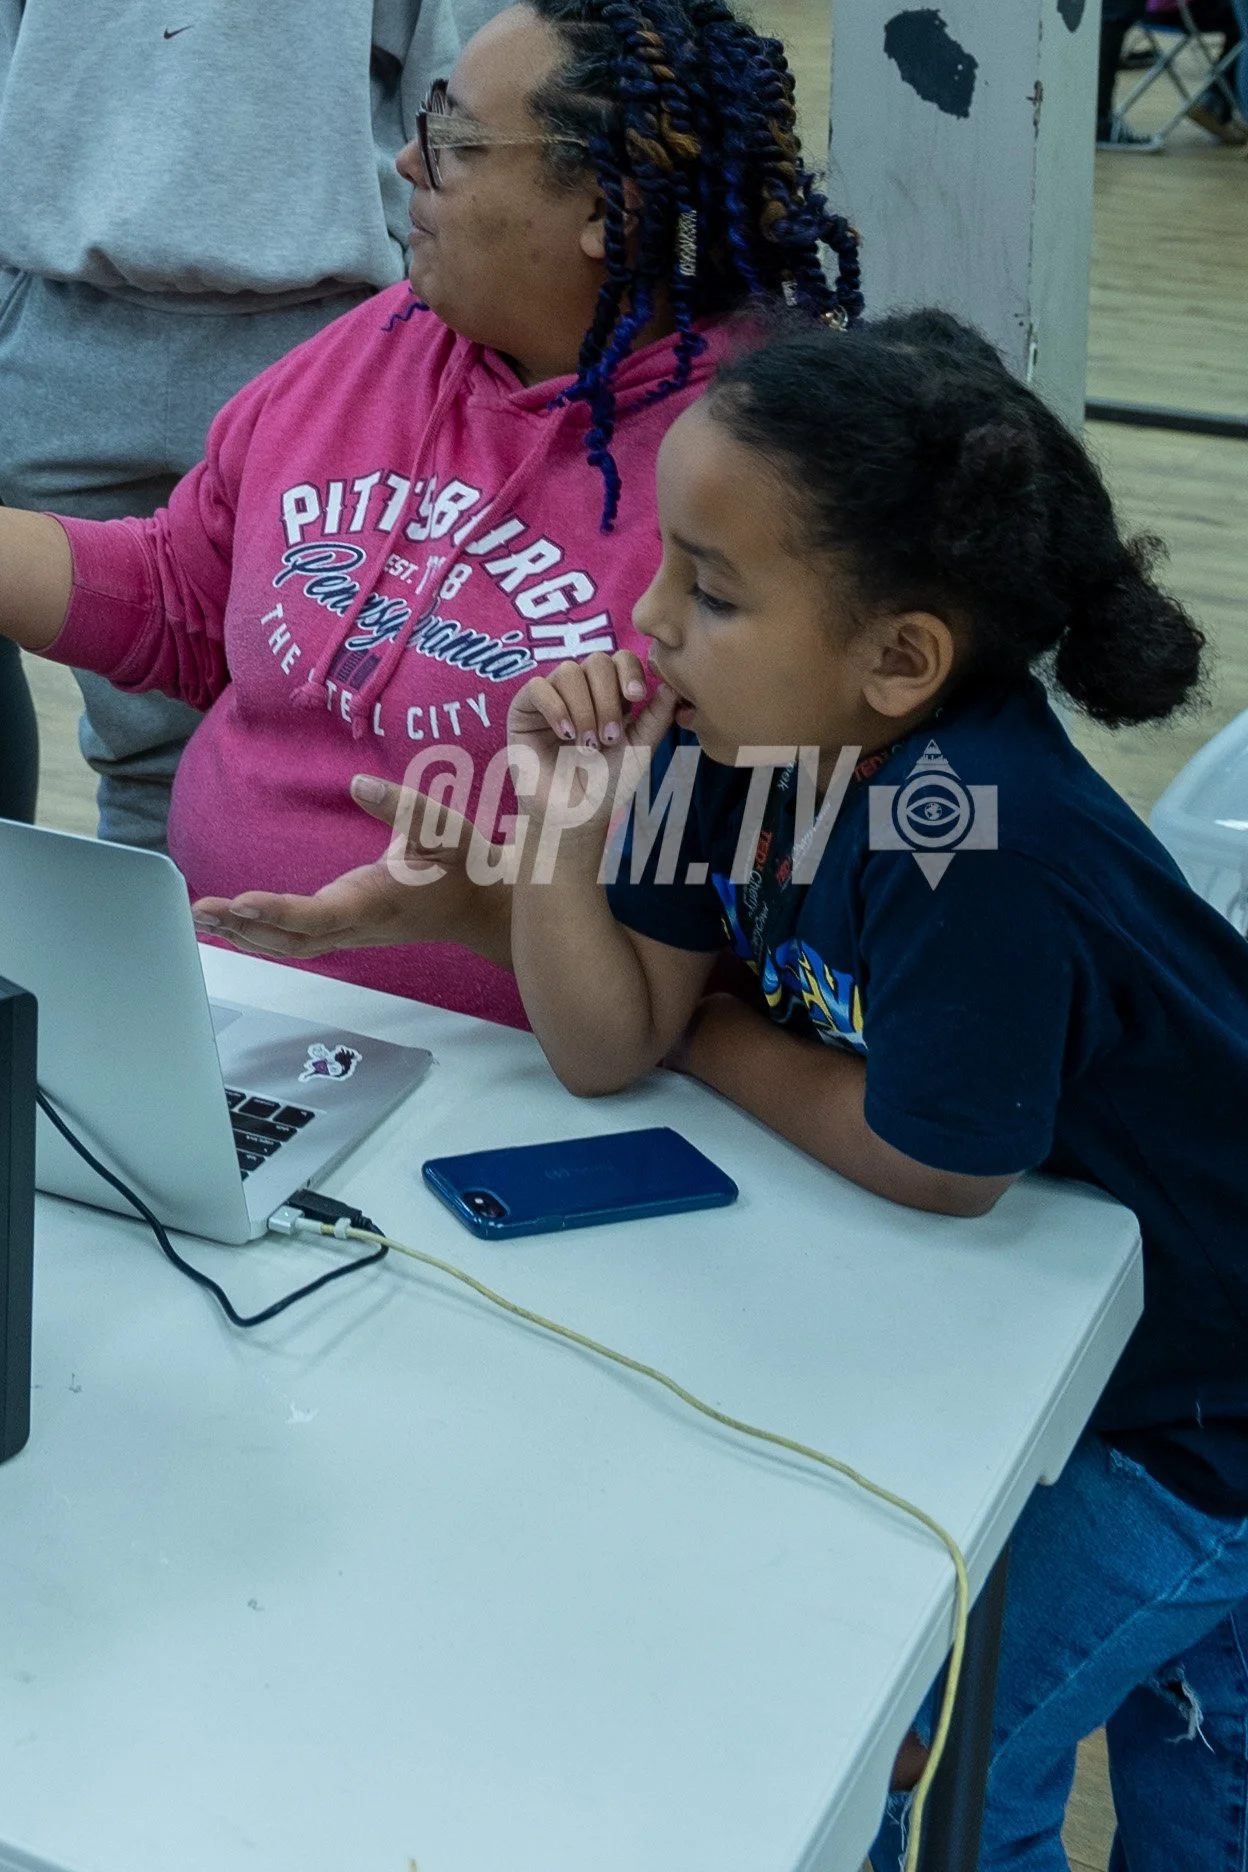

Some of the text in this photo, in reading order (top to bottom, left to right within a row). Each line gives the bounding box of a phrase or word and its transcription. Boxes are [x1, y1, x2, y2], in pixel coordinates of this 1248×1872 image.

[260, 603, 491, 740] THE TEL CITY
